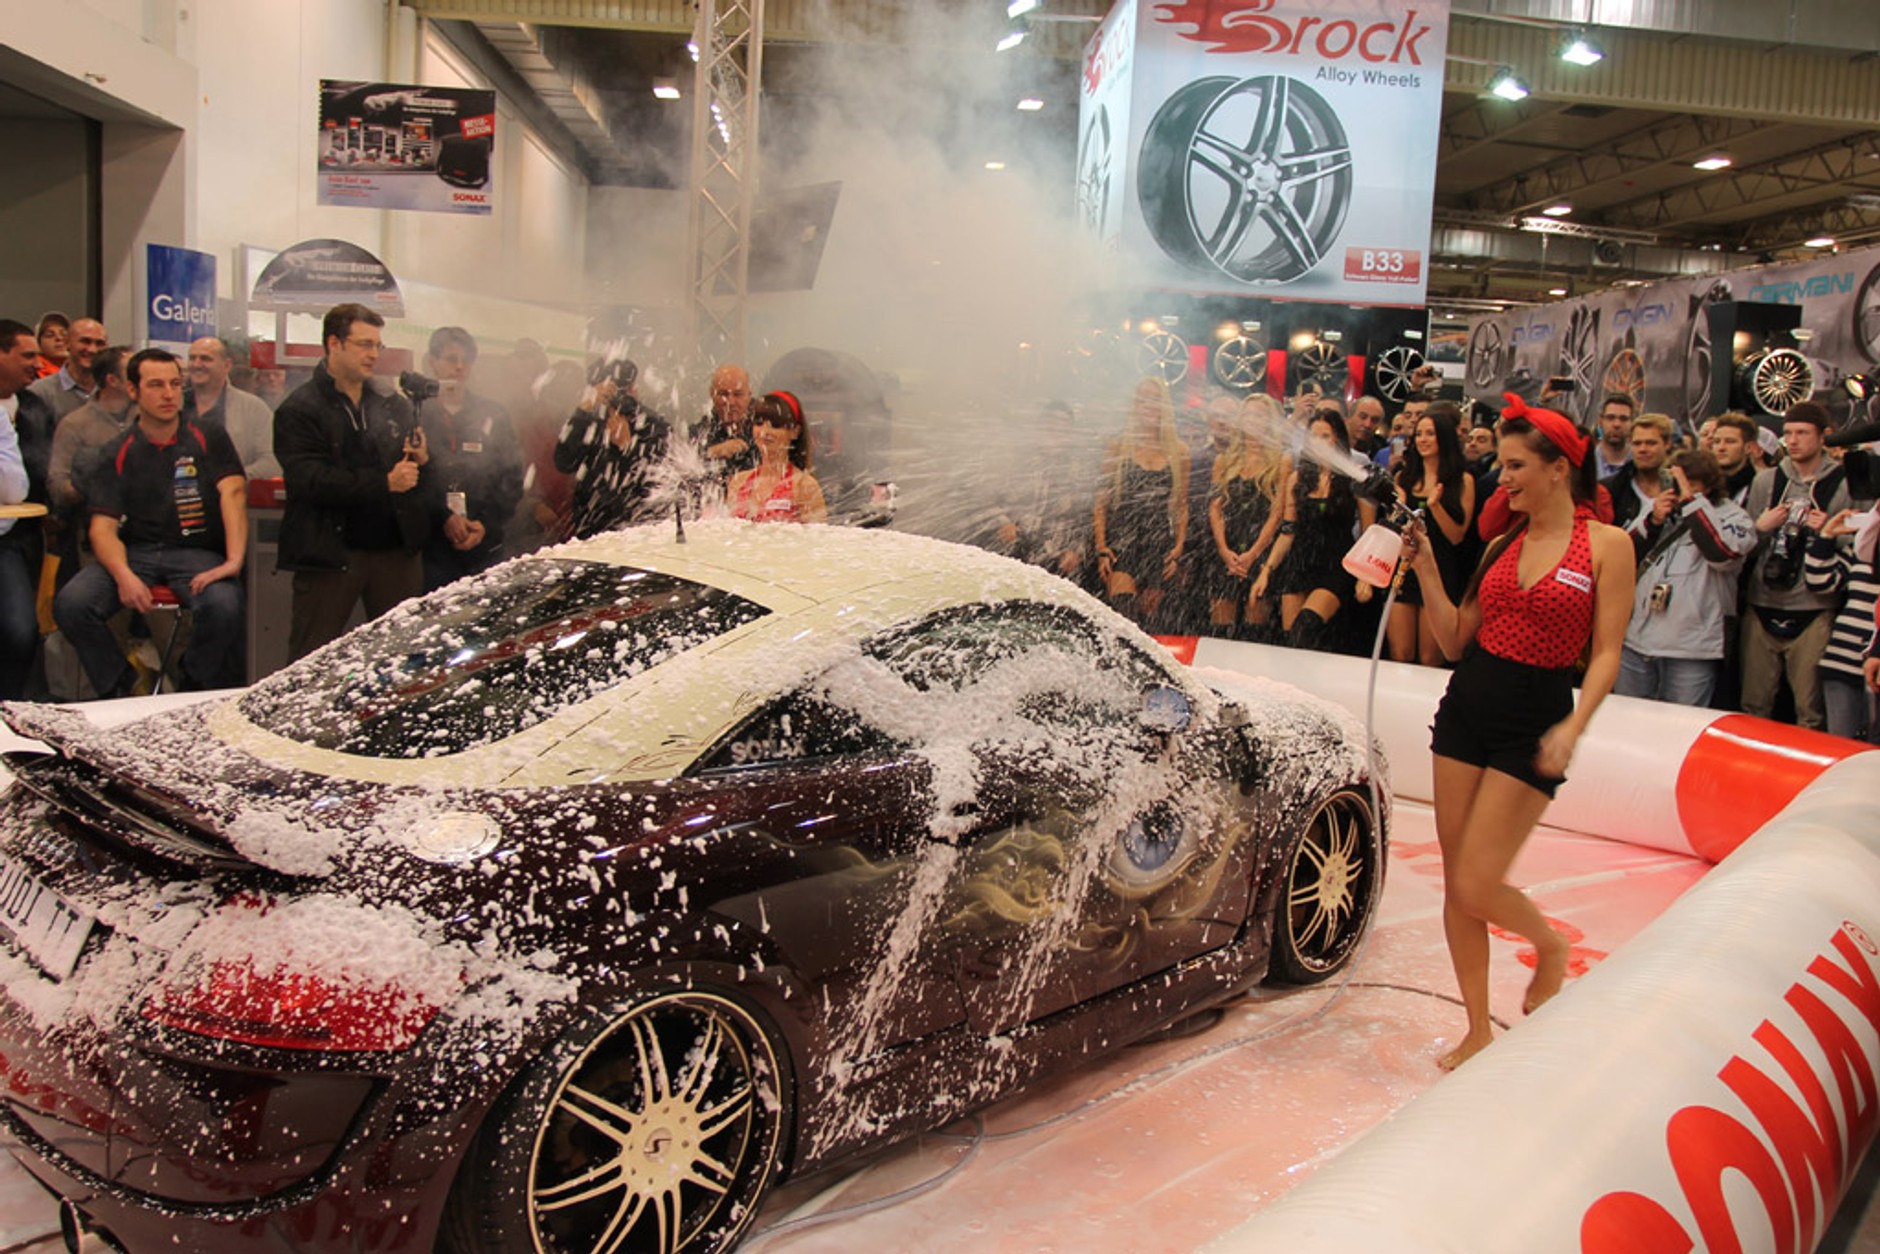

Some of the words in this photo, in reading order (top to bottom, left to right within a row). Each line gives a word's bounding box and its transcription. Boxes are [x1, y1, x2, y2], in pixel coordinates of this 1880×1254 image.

[1316, 66, 1357, 85] Alloy
[1363, 70, 1421, 88] Wheels
[453, 192, 486, 203] SONAX
[1362, 250, 1404, 273] B33
